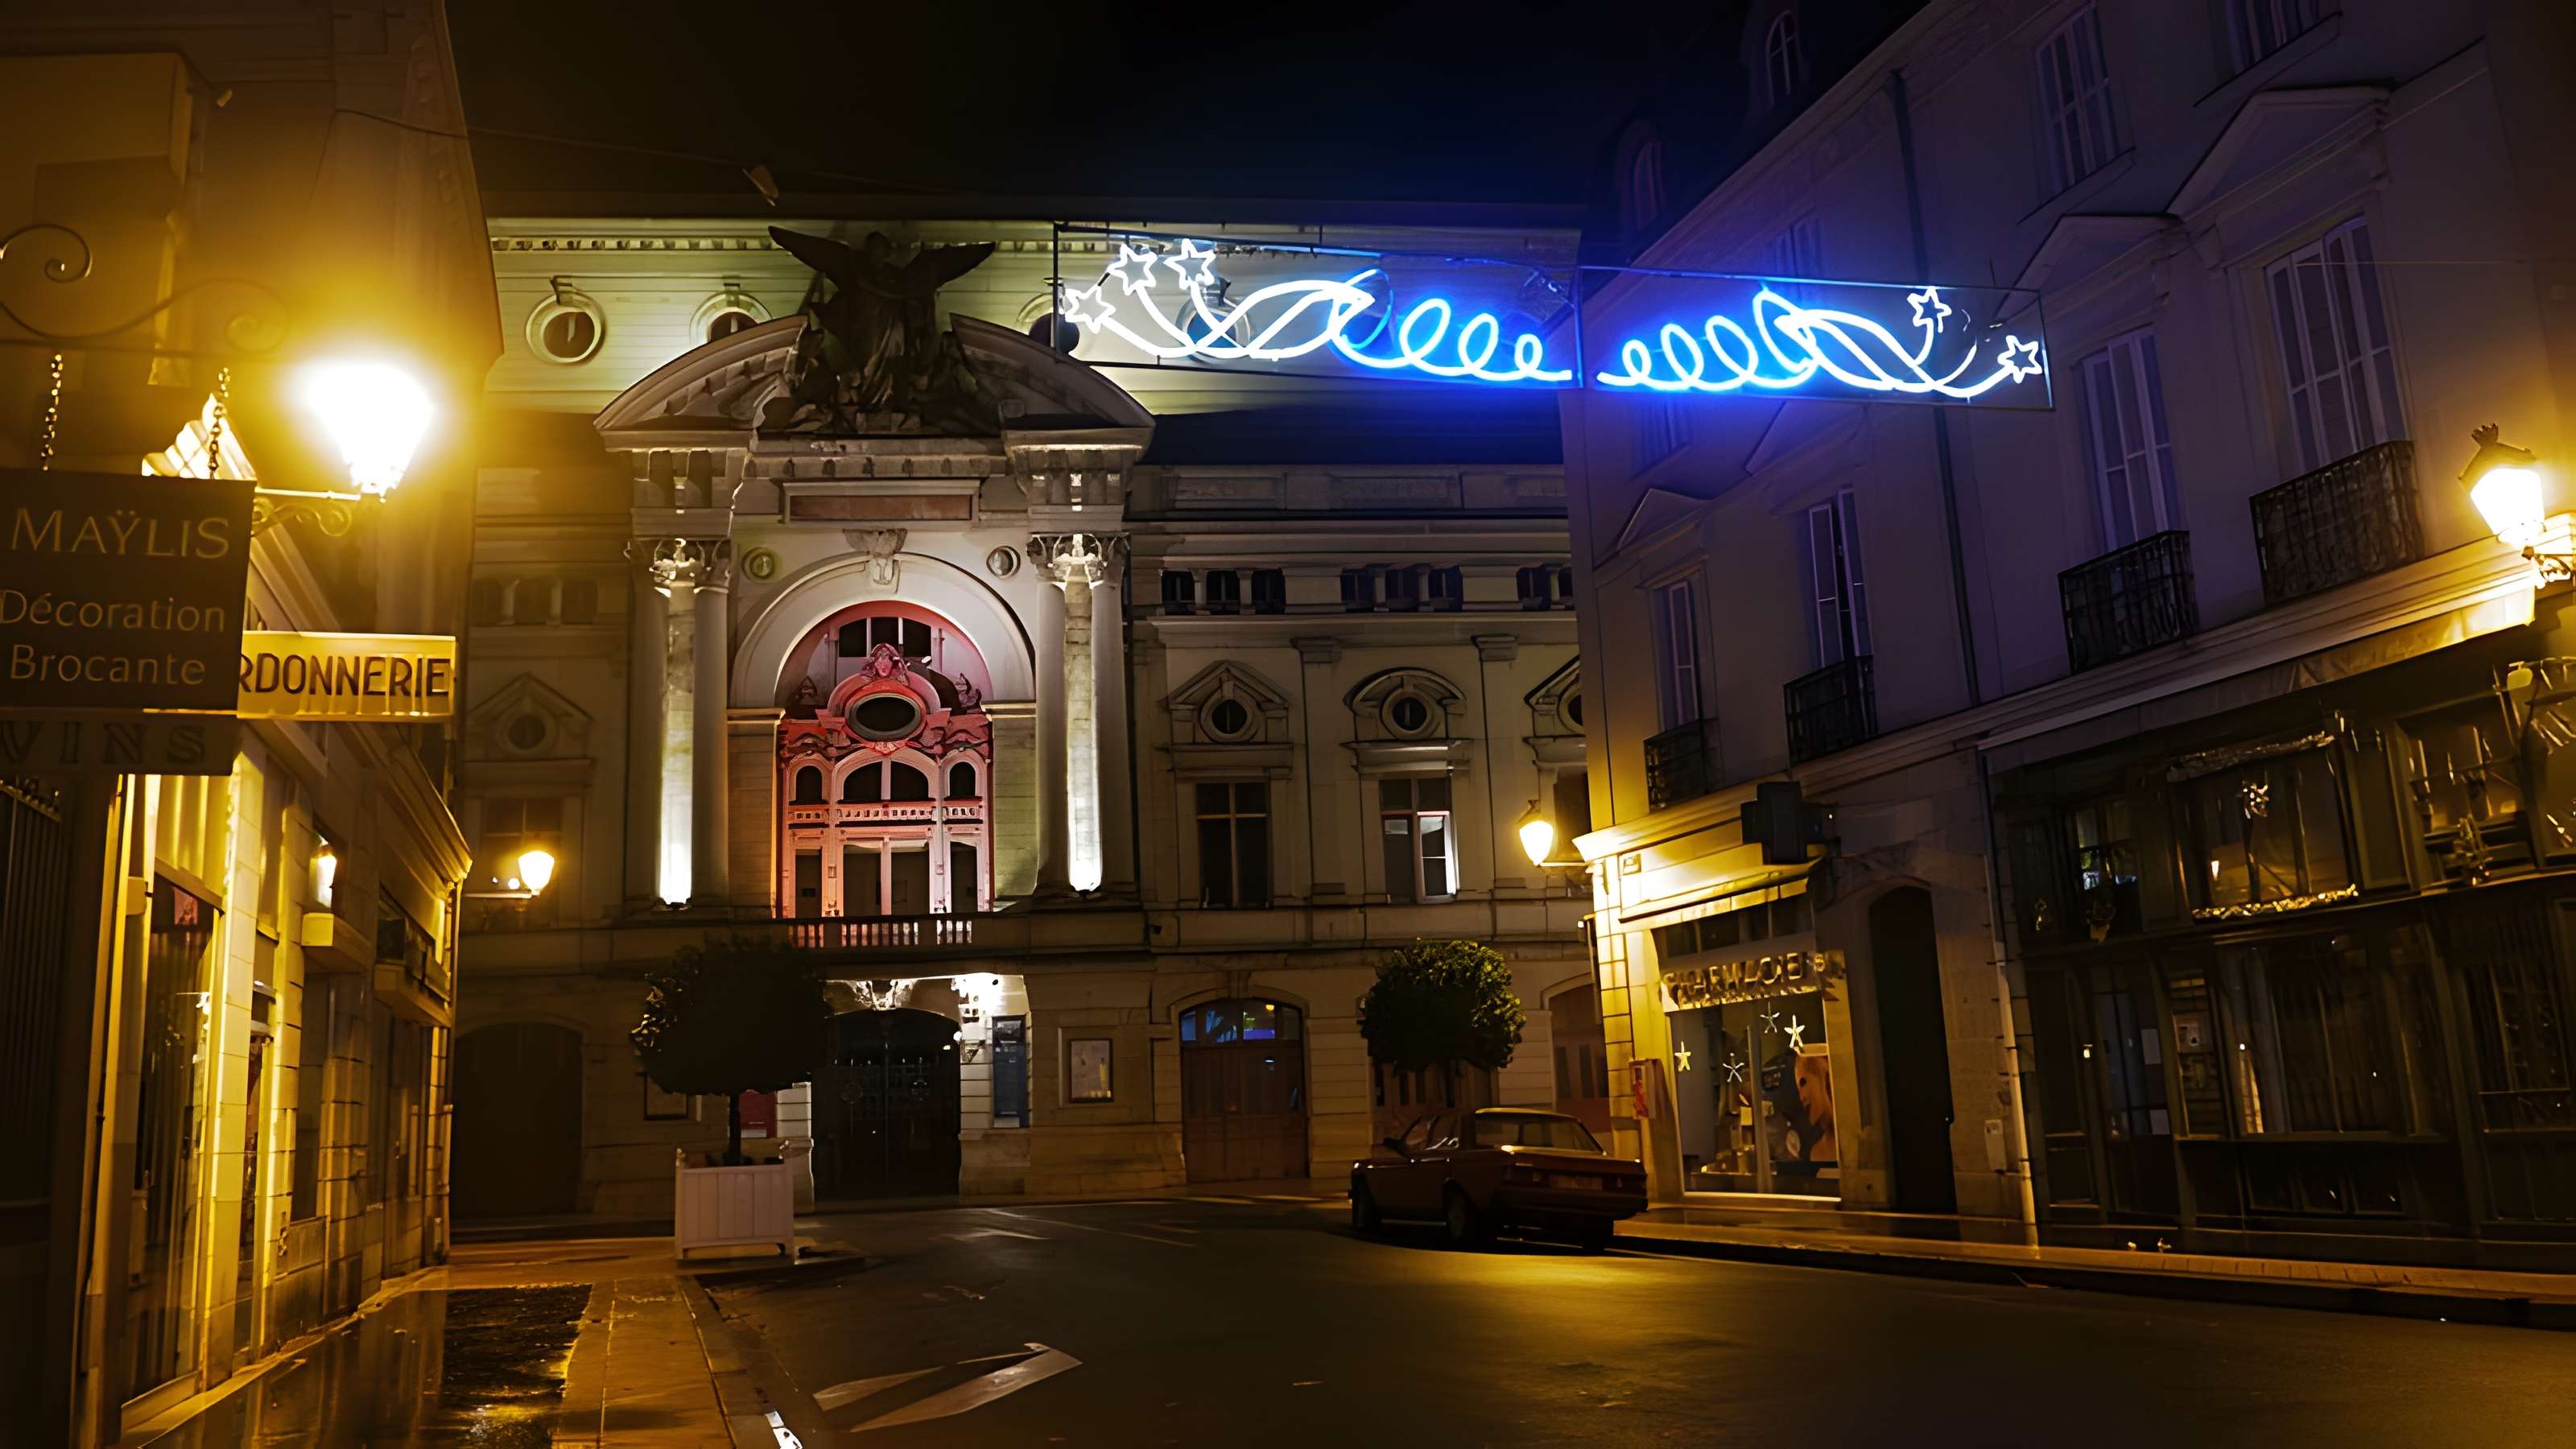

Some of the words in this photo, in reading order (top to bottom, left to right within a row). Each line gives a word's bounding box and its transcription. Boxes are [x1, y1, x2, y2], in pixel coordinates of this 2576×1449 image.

[10, 508, 230, 559] MAŸLIS
[0, 589, 225, 633] Décoration
[10, 643, 206, 685] Brocante
[0, 720, 204, 764] VINS
